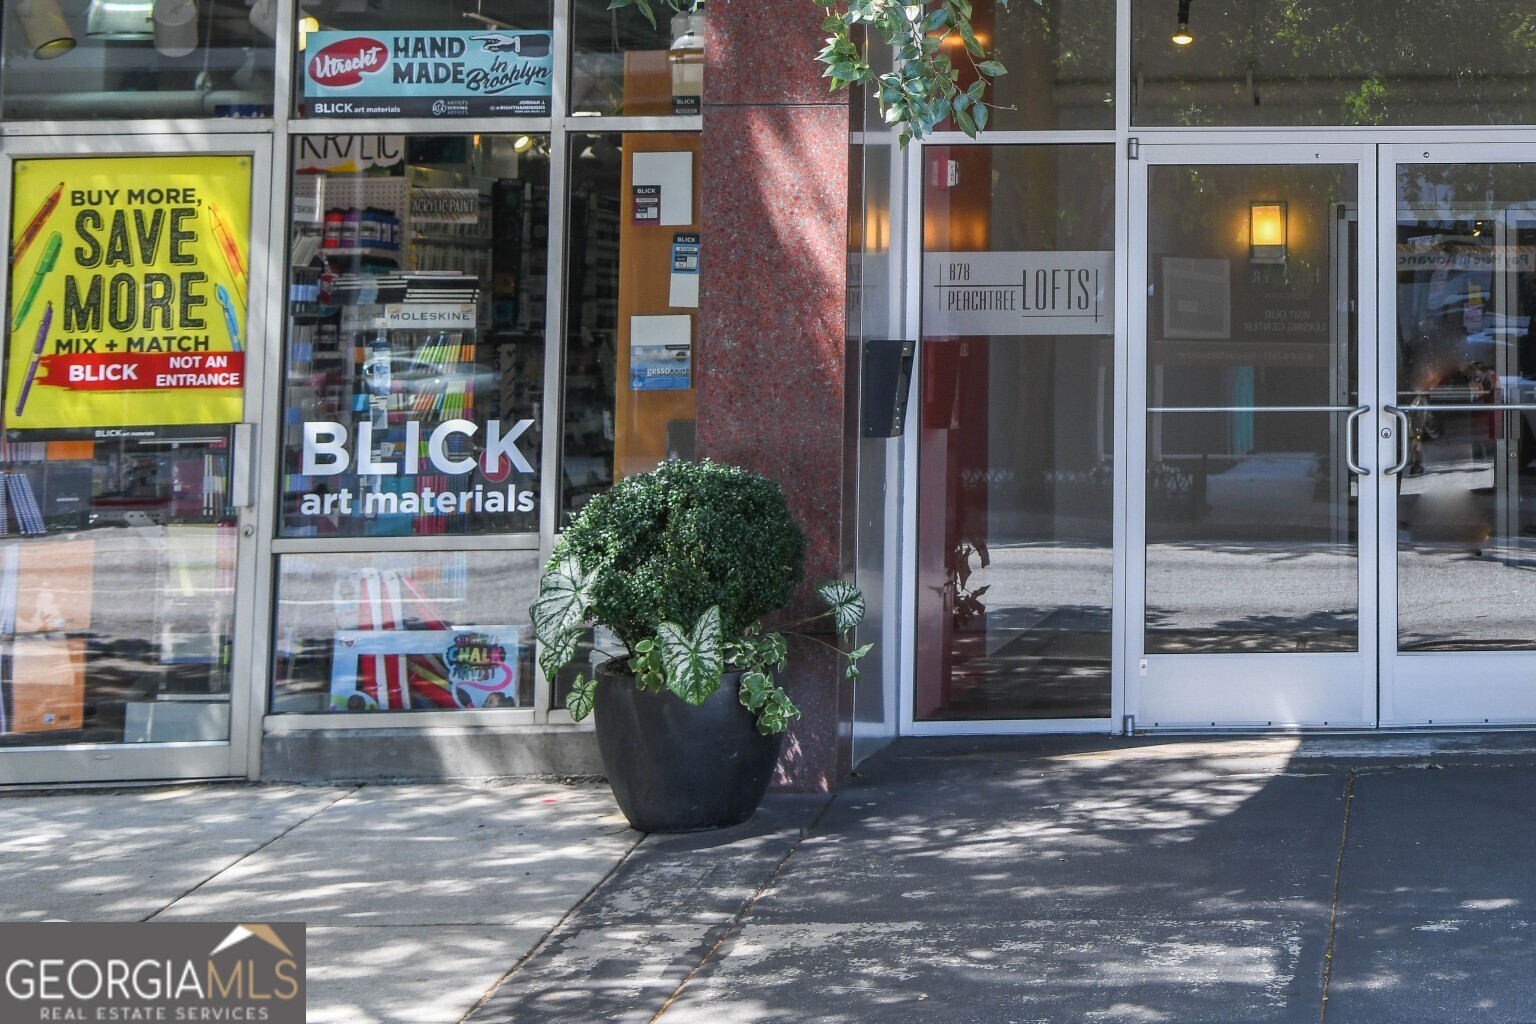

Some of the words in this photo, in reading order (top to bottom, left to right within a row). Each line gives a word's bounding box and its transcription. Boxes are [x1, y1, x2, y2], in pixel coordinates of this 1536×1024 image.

[393, 36, 466, 59] HAND
[315, 47, 382, 78] Utrecht
[491, 55, 508, 73] in
[392, 63, 466, 84] MADE
[315, 103, 353, 113] BLICK
[71, 190, 119, 206] BUY
[128, 188, 202, 206] MORE,
[413, 199, 447, 212] ACRYLIC
[450, 199, 474, 212] PAINT
[74, 208, 198, 268] SAVE
[950, 263, 970, 281] 878
[1022, 269, 1090, 310] LOFTS
[63, 272, 208, 332] MORE
[948, 290, 1016, 311] PEACHTREE
[390, 312, 470, 321] MOLESKINE
[55, 338, 95, 354] MIX
[106, 341, 117, 351] +
[128, 336, 209, 353] MATCH
[169, 356, 202, 369] NOT
[205, 355, 228, 368] AN
[69, 363, 138, 382] BLICK
[156, 372, 240, 387] ENTRANCE
[302, 419, 535, 475] BLICK
[301, 488, 352, 515] art
[365, 484, 535, 514] materials
[448, 646, 503, 663] CHALK
